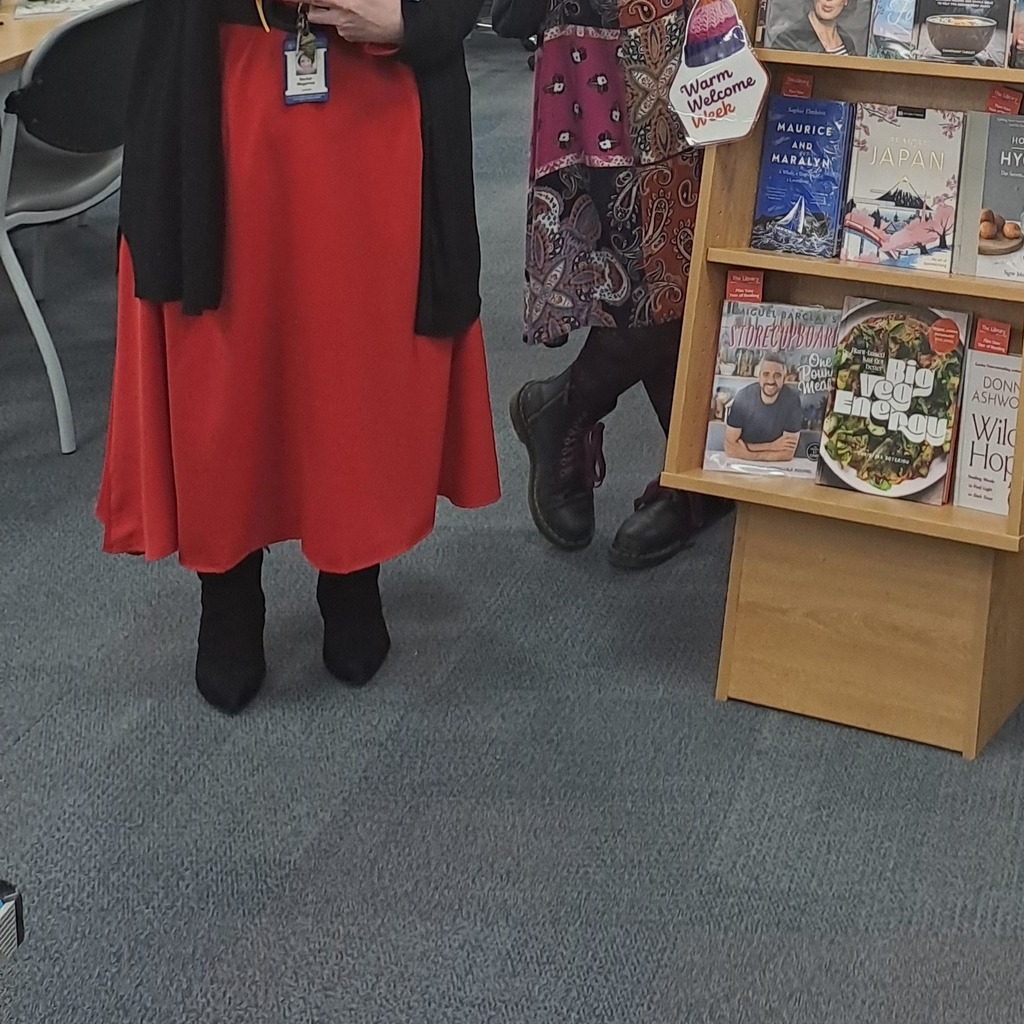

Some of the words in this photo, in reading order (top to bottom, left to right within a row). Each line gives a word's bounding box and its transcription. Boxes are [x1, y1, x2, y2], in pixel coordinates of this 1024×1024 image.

[680, 68, 733, 98] Warm
[687, 76, 756, 114] Welcome
[691, 101, 736, 129] Week
[777, 122, 832, 136] MAURICE
[791, 140, 812, 150] AND
[870, 145, 945, 172] JAPAN
[771, 153, 830, 169] MARALYN
[797, 365, 833, 381] Poun
[808, 353, 833, 368] One
[885, 357, 935, 398] Big
[982, 375, 1021, 393] DONN
[860, 373, 913, 412] Veg
[971, 391, 1020, 410] ASHWO
[833, 389, 948, 447] Energy
[969, 440, 1015, 482] Hop
